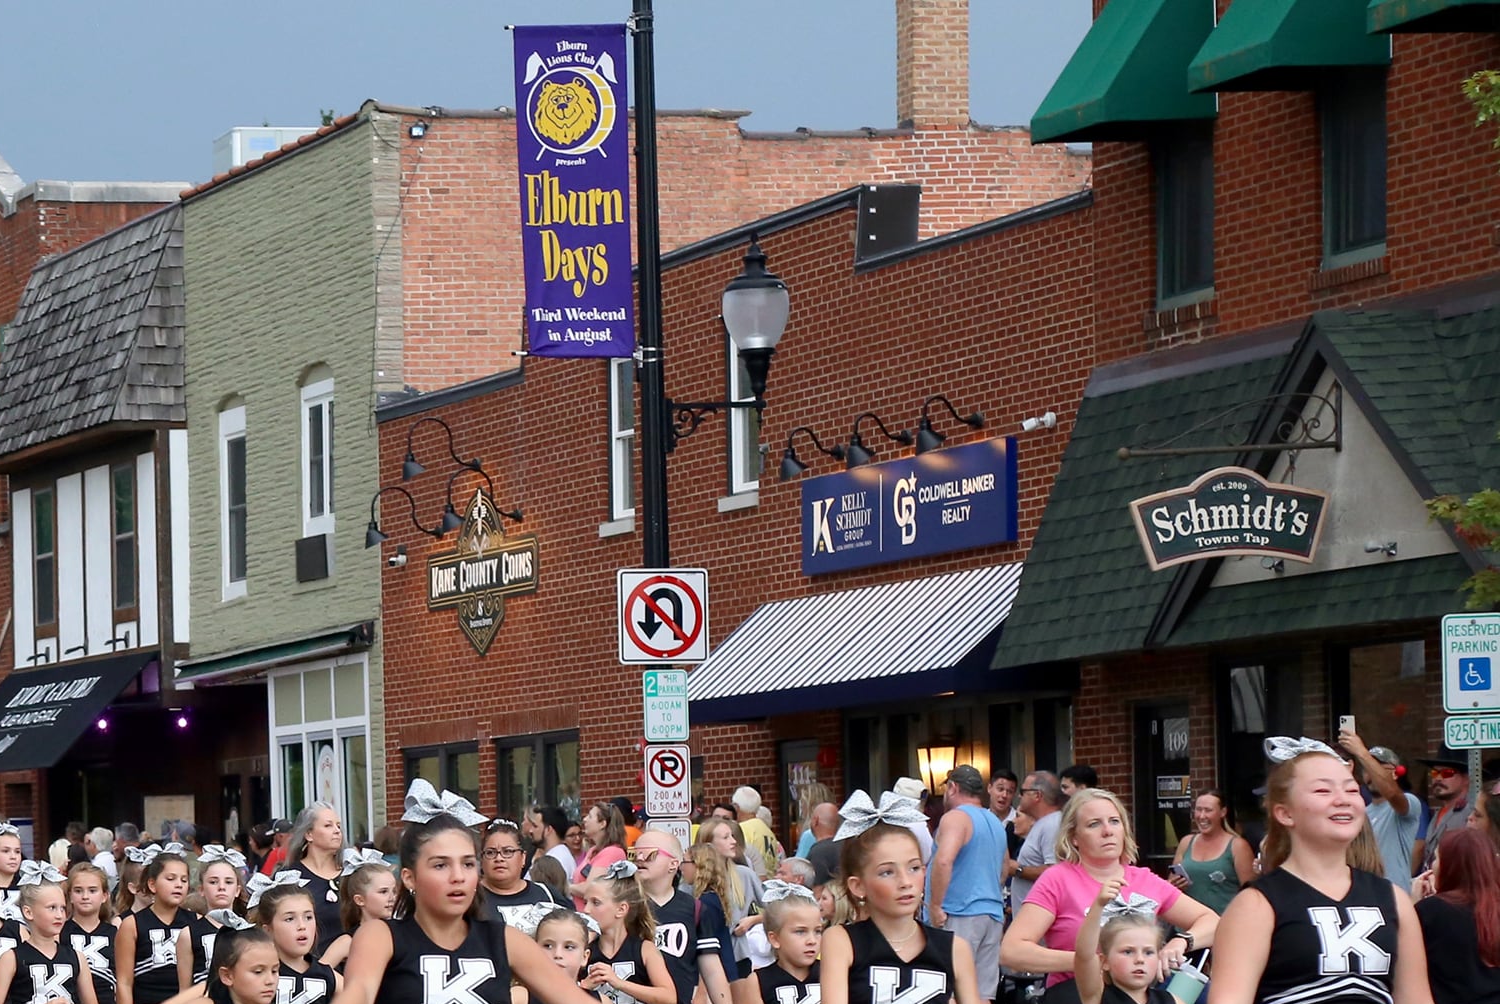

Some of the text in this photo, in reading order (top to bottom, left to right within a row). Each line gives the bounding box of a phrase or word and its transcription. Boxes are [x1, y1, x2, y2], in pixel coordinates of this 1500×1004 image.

[556, 40, 587, 52] Elburn
[546, 52, 596, 67] Lions Club
[555, 157, 586, 166] presents
[524, 170, 624, 226] Elburn
[539, 229, 609, 298] Days
[531, 307, 626, 322] Third Weekend
[547, 328, 612, 347] in August
[918, 473, 995, 504] COLDWELL BANKER
[1212, 481, 1248, 492] est. 2009
[841, 491, 867, 512] KELLY
[836, 508, 872, 531] SCHMIDT
[942, 505, 971, 526] REALTY
[1151, 493, 1309, 544] Schmidt's
[844, 528, 864, 542] GROUP
[1195, 533, 1269, 548] Towne Tap
[1447, 623, 1500, 637] RESERVED
[1451, 640, 1498, 654] PARKING
[646, 676, 656, 694] 2
[666, 674, 678, 683] HR
[658, 684, 685, 694] PARKING
[662, 713, 672, 722] TO
[1449, 723, 1476, 741] $250
[1168, 732, 1188, 752] 109
[654, 791, 683, 800] 2:00 AM
[660, 802, 675, 811] 5:00
[678, 801, 689, 810] AM
[148, 928, 182, 964] K
[1307, 906, 1391, 976] K
[71, 934, 109, 969] K
